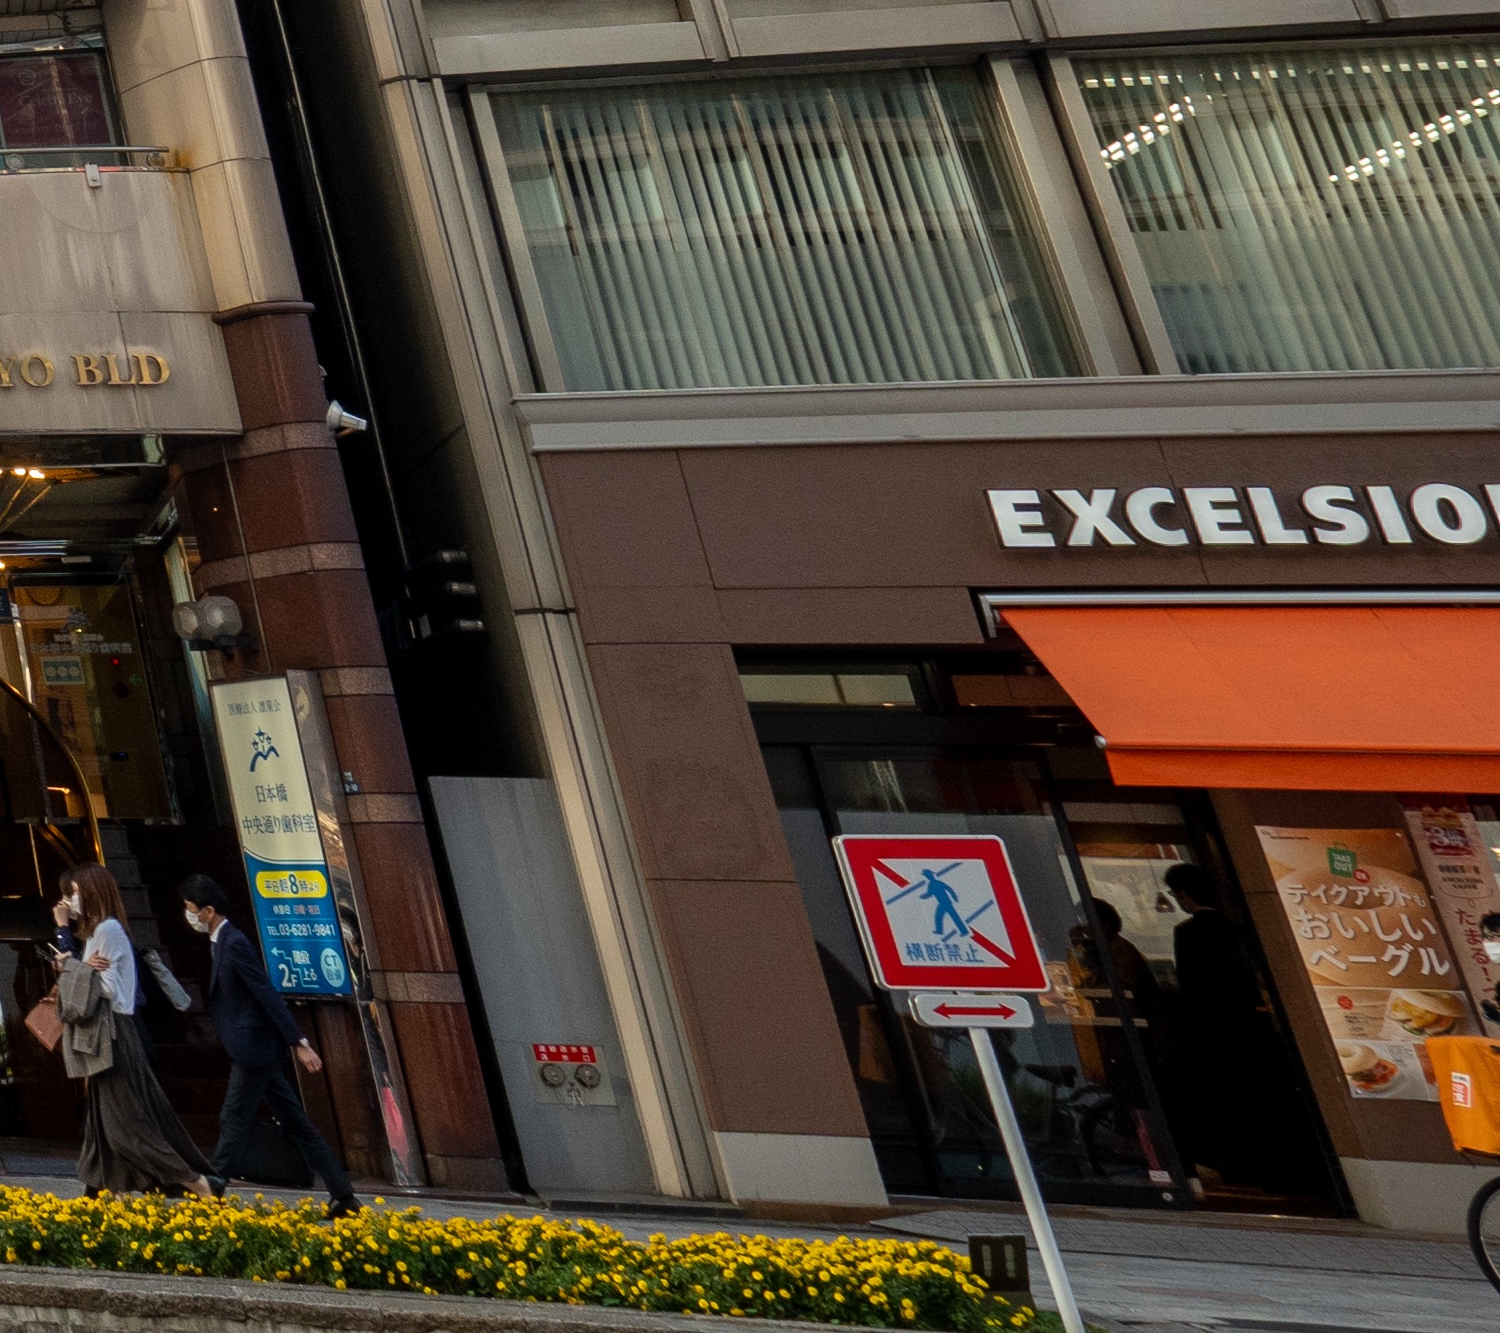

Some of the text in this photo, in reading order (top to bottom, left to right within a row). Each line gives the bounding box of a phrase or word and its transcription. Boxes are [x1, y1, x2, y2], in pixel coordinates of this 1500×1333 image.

[71, 353, 171, 387] BLD
[255, 783, 289, 804] 日本橋
[242, 813, 316, 836] 中央通り歯科室
[1287, 884, 1427, 908] テイクアウトも
[278, 922, 336, 937] 03-6281-9841
[1295, 908, 1437, 941] おいしい
[324, 953, 338, 967] CT
[905, 942, 985, 963] 横断禁止
[1308, 943, 1450, 977] ベーグル
[277, 963, 298, 988] 2F
[303, 968, 318, 982] 上る
